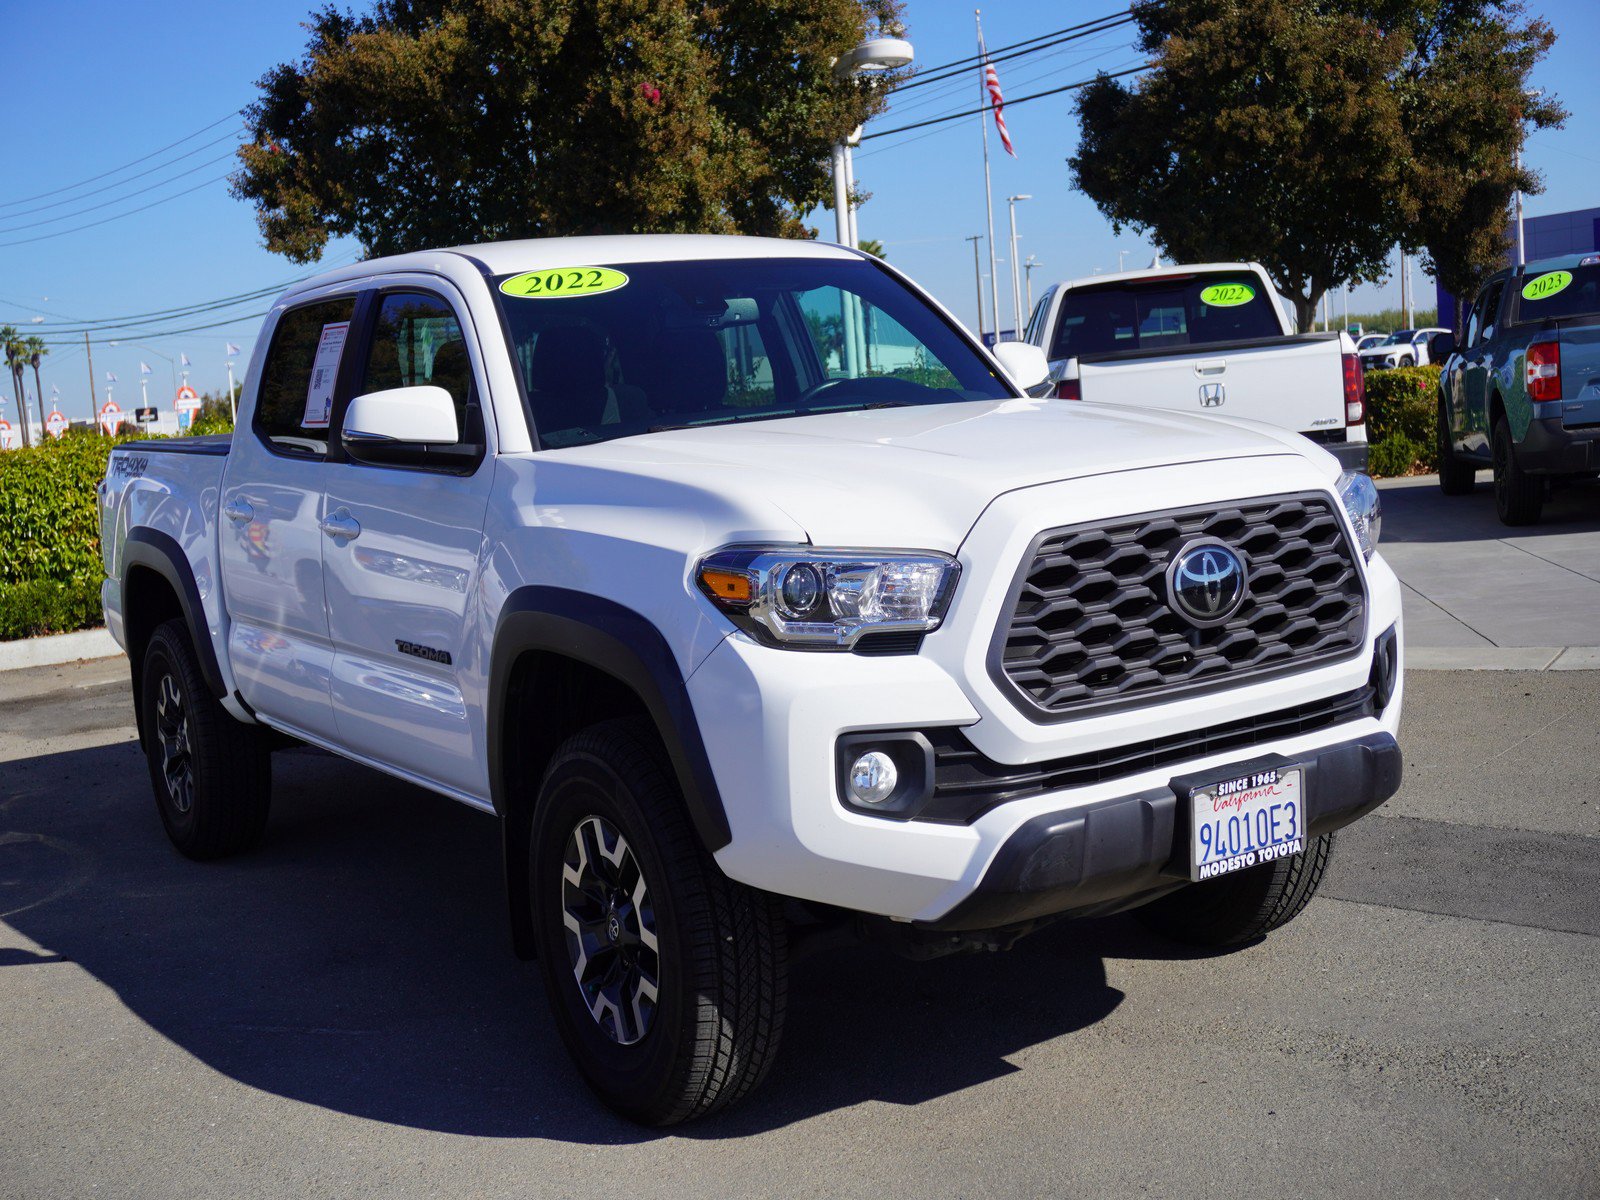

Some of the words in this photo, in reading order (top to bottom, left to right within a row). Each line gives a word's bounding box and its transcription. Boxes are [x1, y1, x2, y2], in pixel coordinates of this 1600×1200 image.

[524, 270, 604, 294] 2022
[1210, 287, 1244, 301] 2022
[1530, 274, 1562, 297] 2023
[1310, 418, 1338, 426] AWD
[395, 639, 453, 665] TACOMA
[1218, 777, 1248, 796] SINCE
[1252, 770, 1277, 787] 1965
[1213, 785, 1283, 813] California
[1200, 801, 1297, 865] 94010E3
[1200, 852, 1256, 880] MODESTO
[1257, 839, 1302, 863] TOYOTA
